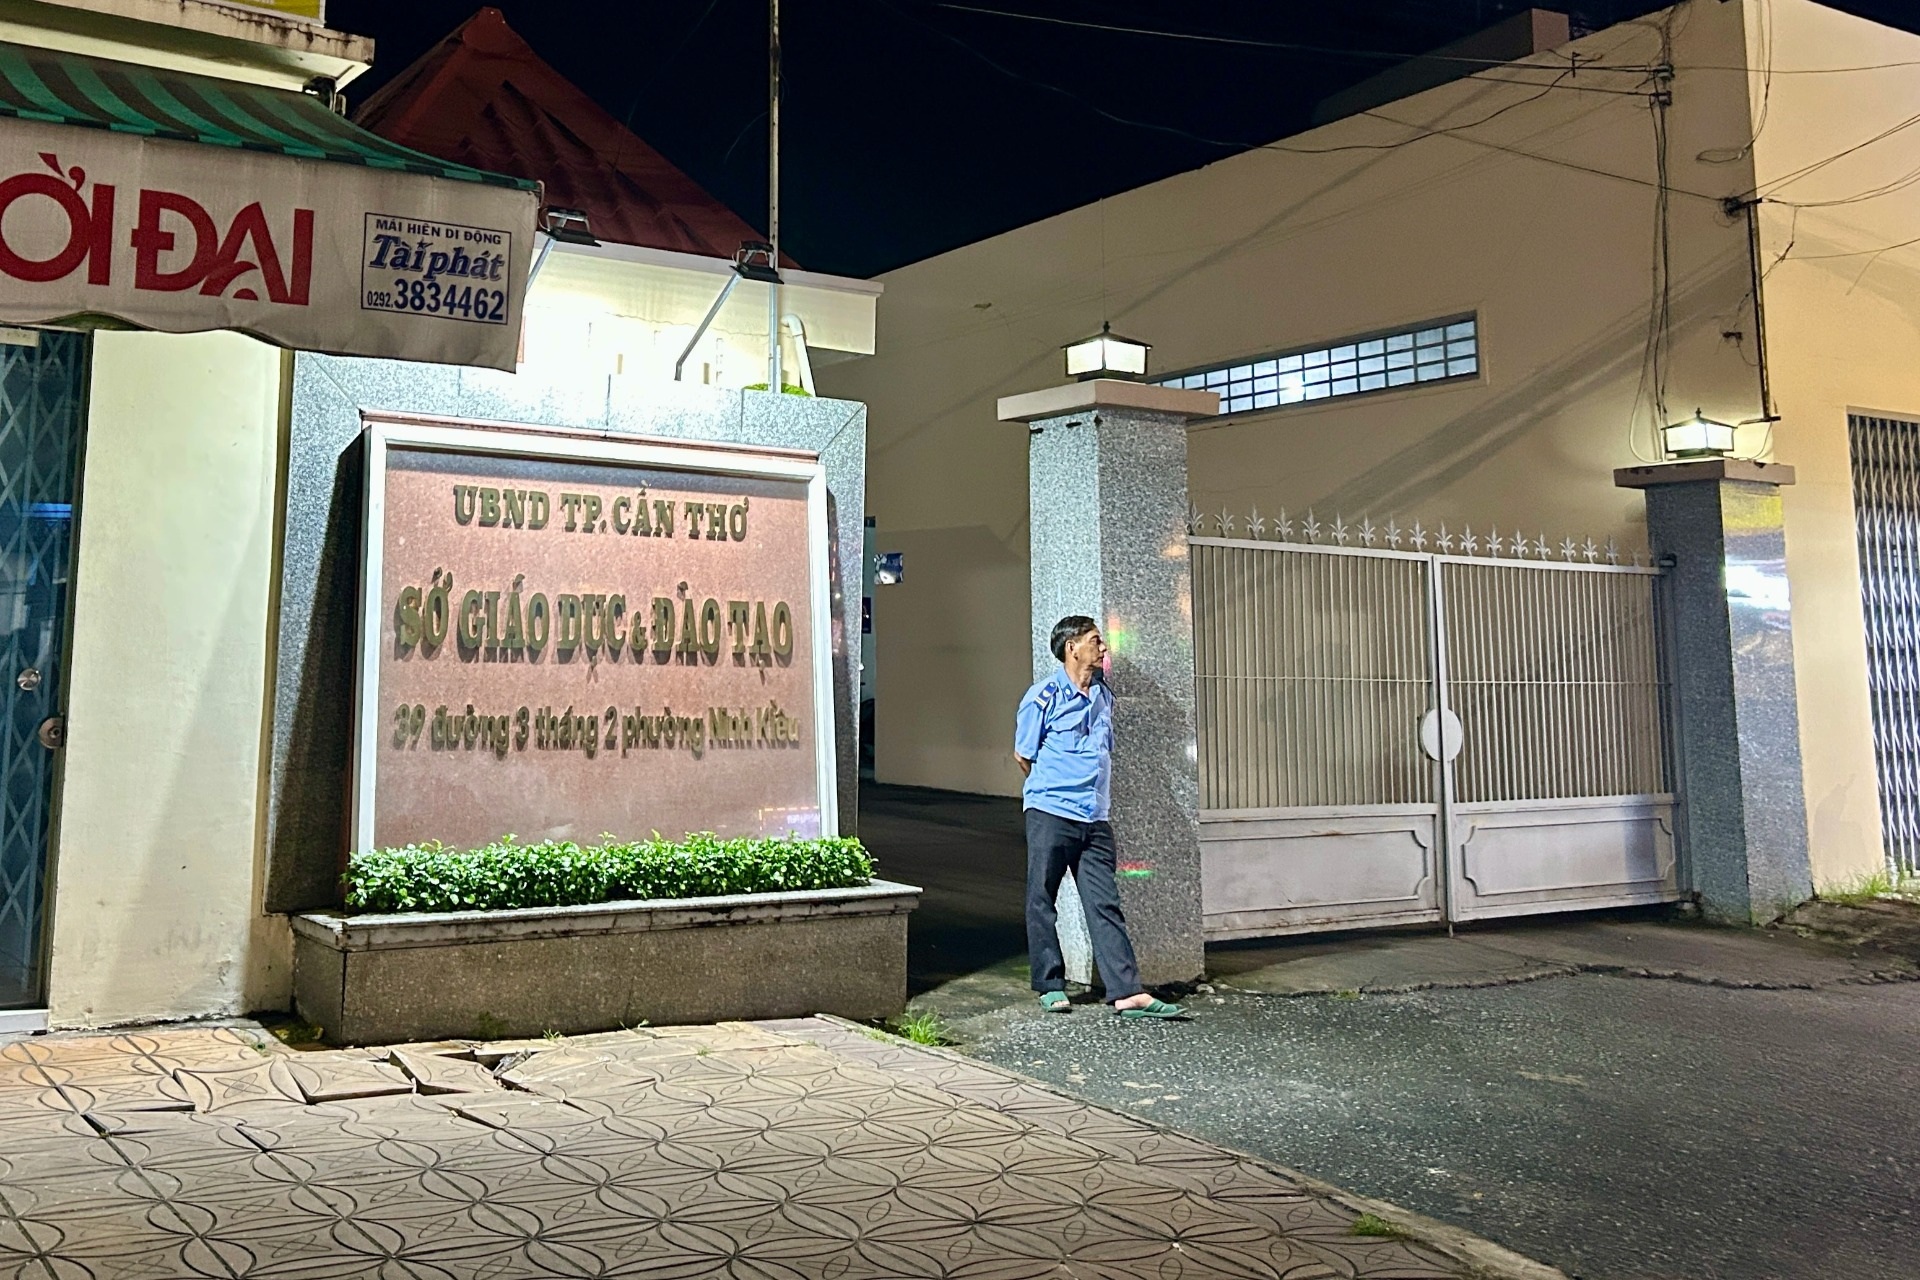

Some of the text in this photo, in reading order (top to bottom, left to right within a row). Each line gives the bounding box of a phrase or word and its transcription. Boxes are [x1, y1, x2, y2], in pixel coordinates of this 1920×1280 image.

[445, 228, 459, 239] DI
[464, 230, 501, 245] ĐỘNG
[453, 484, 550, 530] UBND
[684, 496, 749, 542] THƠ
[394, 567, 453, 648] SỞ
[457, 573, 550, 655] GIÁO
[395, 703, 426, 748] 39
[431, 704, 510, 758] đường
[516, 706, 530, 748] 3
[535, 705, 599, 757] tháng
[604, 706, 617, 748] 2
[621, 706, 704, 758] phường
[708, 707, 752, 748] Ninh
